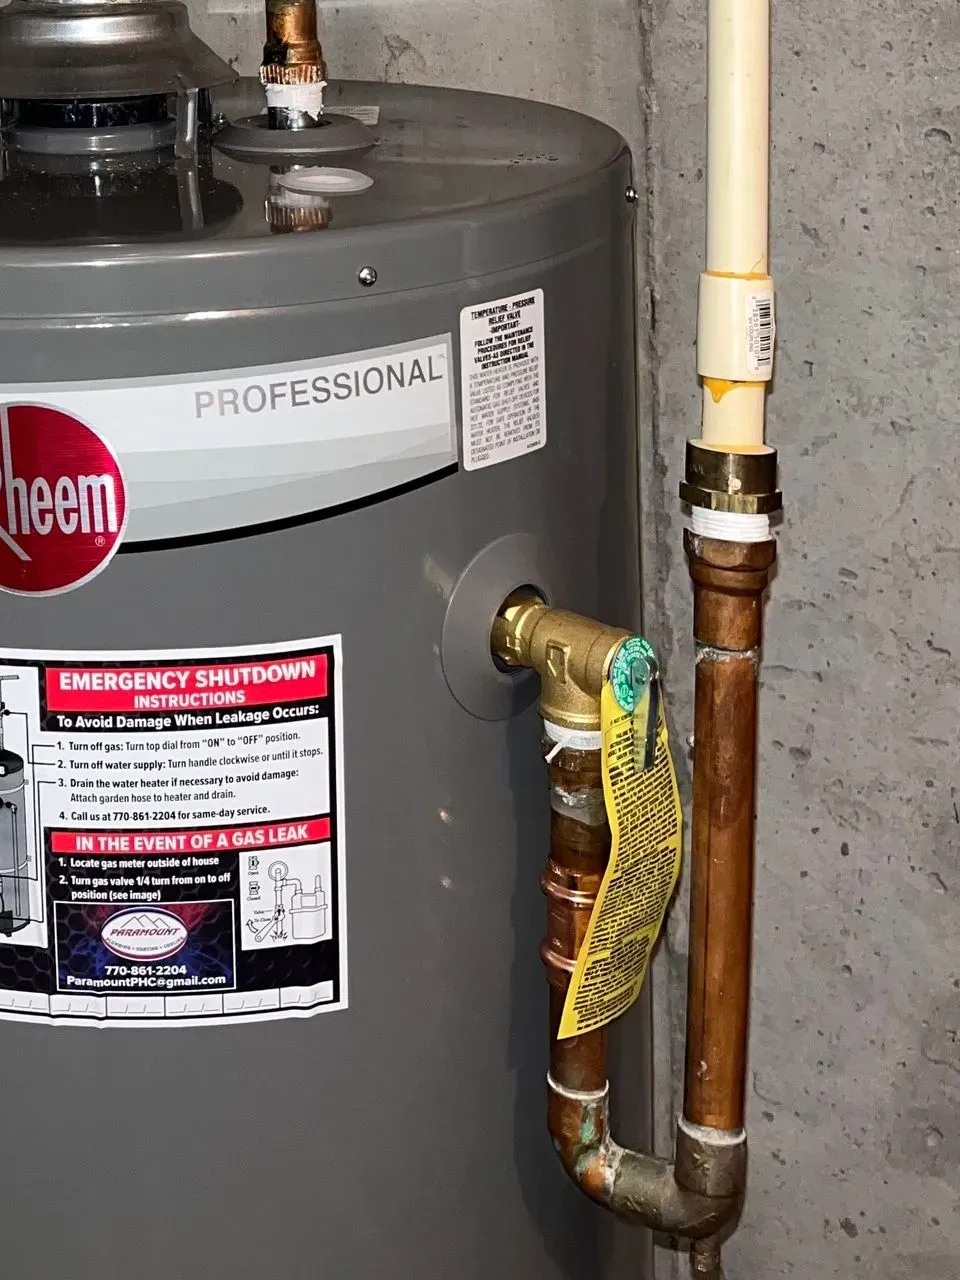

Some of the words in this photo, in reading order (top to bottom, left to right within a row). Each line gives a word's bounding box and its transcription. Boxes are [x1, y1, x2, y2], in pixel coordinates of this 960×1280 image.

[471, 304, 508, 320] TEMPERATURE
[512, 296, 535, 310] PRESSURE
[489, 314, 505, 326] RELIEF
[507, 310, 520, 320] VALVE
[475, 338, 493, 347] FOLLOW
[504, 326, 533, 340] MAINTENANCE
[478, 342, 507, 354] PROCEDURES
[518, 335, 531, 343] RELIEF
[500, 346, 520, 357] DIRECTED
[481, 357, 510, 370] INSTRUCTION
[512, 352, 528, 361] MANUAL
[195, 356, 442, 418] PROFESSIONAL
[59, 671, 190, 691] EMERGENCY
[195, 660, 315, 688] SHUTDOWN
[134, 690, 246, 709] INSTRUCTIONS
[57, 715, 72, 728] To
[75, 716, 113, 729] Avoid
[116, 714, 171, 731] Damage
[175, 711, 212, 727] When
[215, 707, 270, 726] Leakage
[272, 704, 319, 720] Occurs:
[69, 742, 88, 751] Turn
[90, 742, 102, 751] off
[105, 742, 123, 753] gas:
[126, 742, 145, 751] Turn
[146, 742, 160, 752] top
[162, 741, 178, 750] dial
[180, 739, 200, 750] from
[227, 738, 235, 746] to
[265, 732, 301, 745] position.
[70, 760, 89, 769] Turn
[91, 760, 103, 769] off
[105, 761, 131, 770] water
[133, 760, 166, 771] supply:
[168, 759, 186, 768] Turn
[188, 757, 217, 768] handle
[219, 754, 259, 766] clockwise
[261, 753, 270, 762] or
[272, 751, 290, 761] until
[292, 750, 297, 758] it
[300, 748, 323, 758] stops.
[70, 778, 94, 788] Drain
[96, 779, 110, 788] the
[112, 779, 138, 788] water
[141, 779, 169, 787] heater
[171, 778, 177, 786] if
[179, 776, 223, 786] necessary
[236, 772, 259, 782] avoid
[262, 769, 299, 780] damage:
[70, 793, 97, 802] Attach
[100, 793, 129, 804] garden
[131, 794, 151, 802] hose
[153, 794, 162, 802] to
[164, 793, 191, 801] heater
[194, 791, 209, 800] and
[211, 789, 235, 799] drain.
[71, 811, 88, 820] Call
[113, 811, 175, 821] 770-861-2204
[178, 811, 190, 820] for
[192, 808, 235, 819] same-day
[237, 805, 270, 816] service.
[76, 837, 93, 851] IN
[97, 836, 129, 851] THE
[134, 835, 186, 851] EVENT
[191, 834, 213, 849] OF
[216, 833, 228, 847] A
[232, 829, 265, 846] GAS
[269, 824, 308, 843] LEAK
[70, 858, 99, 868] Locate
[102, 860, 117, 870] gas
[119, 859, 145, 868] meter
[147, 857, 180, 867] outside
[182, 857, 191, 867] of
[192, 856, 219, 866] house
[71, 875, 90, 885] Turn
[92, 877, 108, 887] gas
[110, 876, 134, 886] valve
[136, 875, 150, 886] 1/4
[152, 876, 170, 885] turn
[172, 874, 192, 885] from
[195, 875, 206, 884] on
[207, 874, 217, 883] to
[218, 872, 230, 882] off
[72, 890, 107, 900] position
[109, 890, 128, 901] (see
[130, 890, 161, 901] image)
[110, 928, 180, 937] PARAMOUNT
[104, 965, 187, 975] 770-861-2204
[66, 976, 226, 989] ParamountPHC@gmail.com
